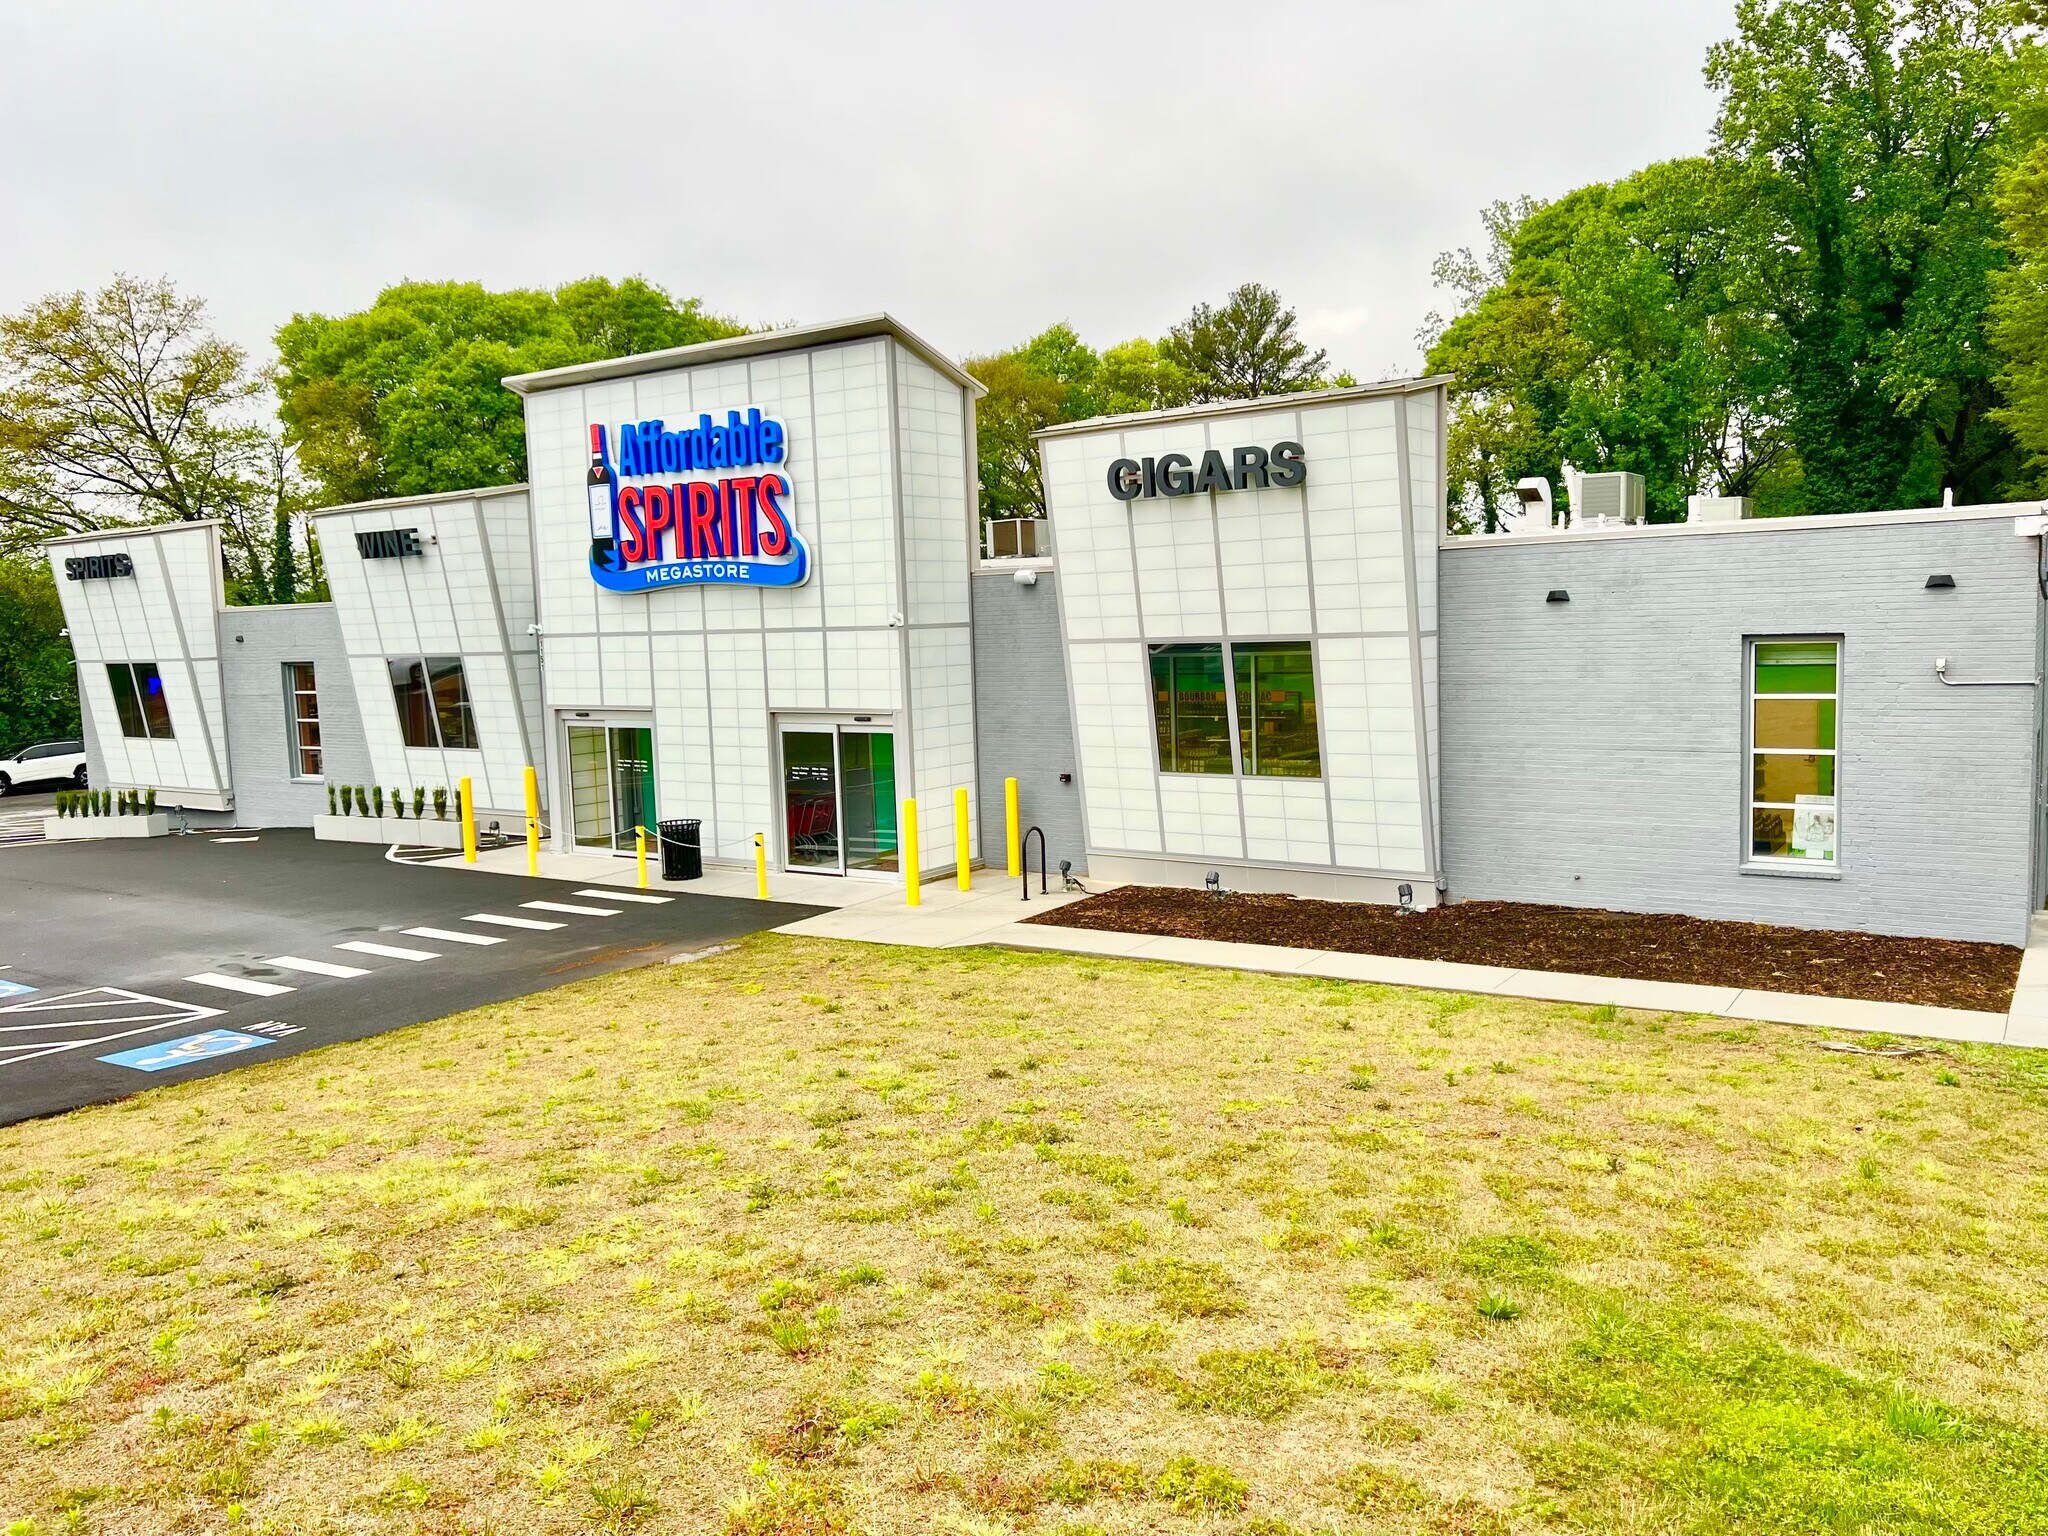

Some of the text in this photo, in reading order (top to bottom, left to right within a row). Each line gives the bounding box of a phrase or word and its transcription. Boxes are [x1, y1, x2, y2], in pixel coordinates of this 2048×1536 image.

[619, 408, 784, 477] Affordable
[1107, 441, 1306, 500] CIGARS
[618, 474, 789, 562] SPIRITS
[354, 528, 422, 559] WINE
[65, 553, 132, 581] SPIRITS
[646, 564, 750, 583] MEGASTORE
[1178, 691, 1217, 701] BOURBON
[1238, 691, 1272, 701] COAC
[240, 1020, 307, 1037] VAN
